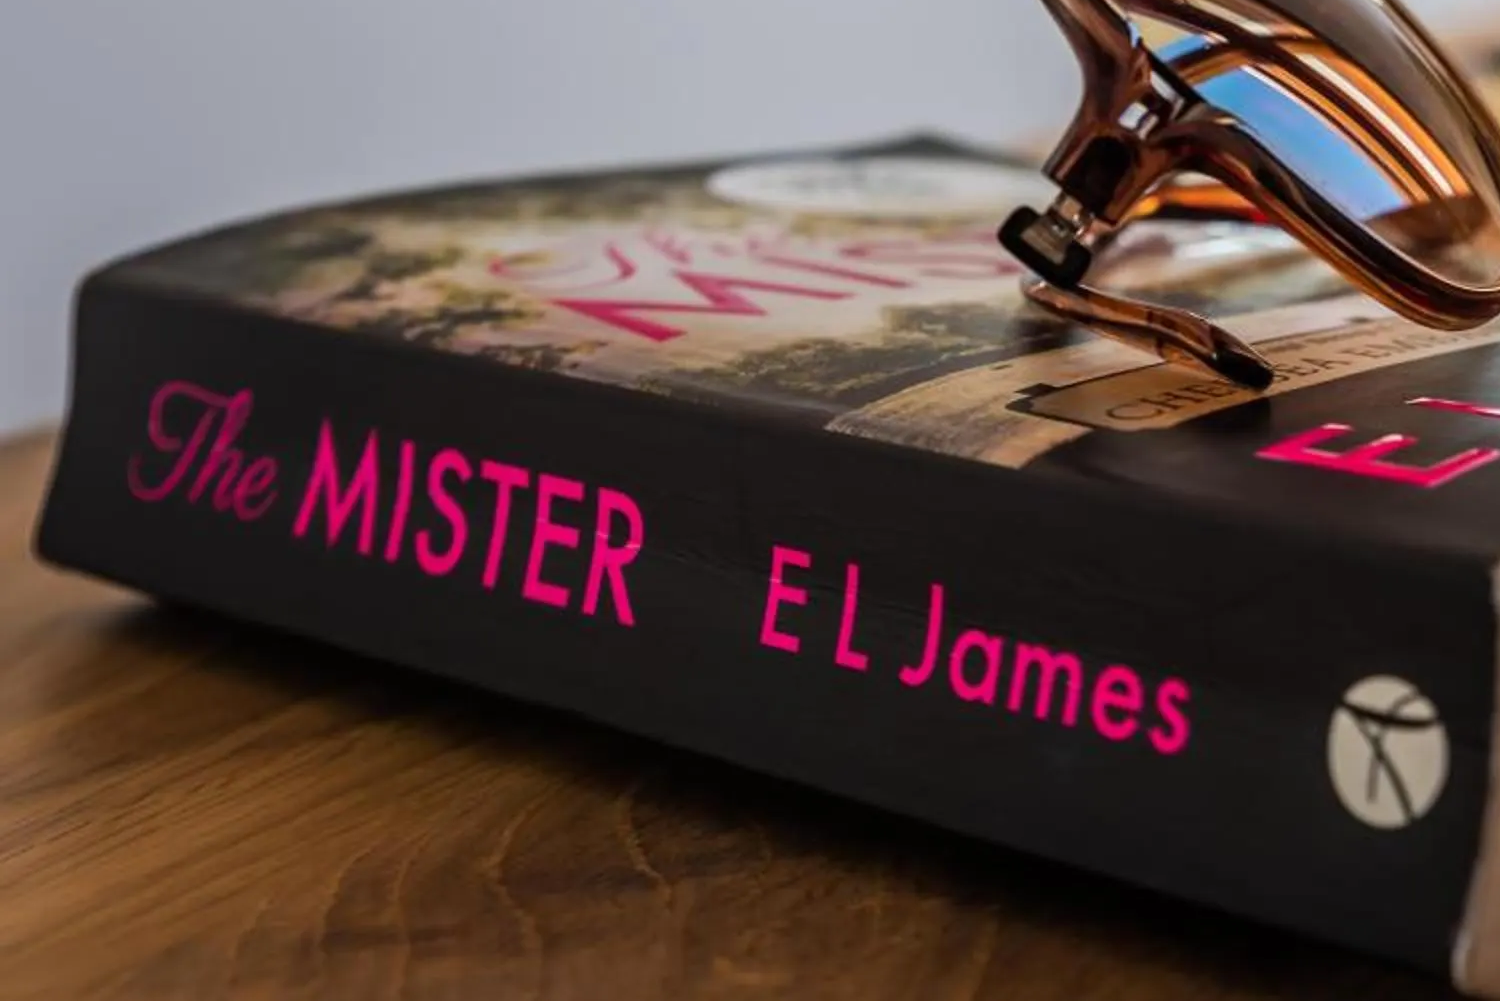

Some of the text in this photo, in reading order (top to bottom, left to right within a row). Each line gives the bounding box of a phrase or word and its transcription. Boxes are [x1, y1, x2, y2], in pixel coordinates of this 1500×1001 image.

[1105, 357, 1352, 420] CHESEA
[128, 379, 1193, 757] The MISTER E L James
